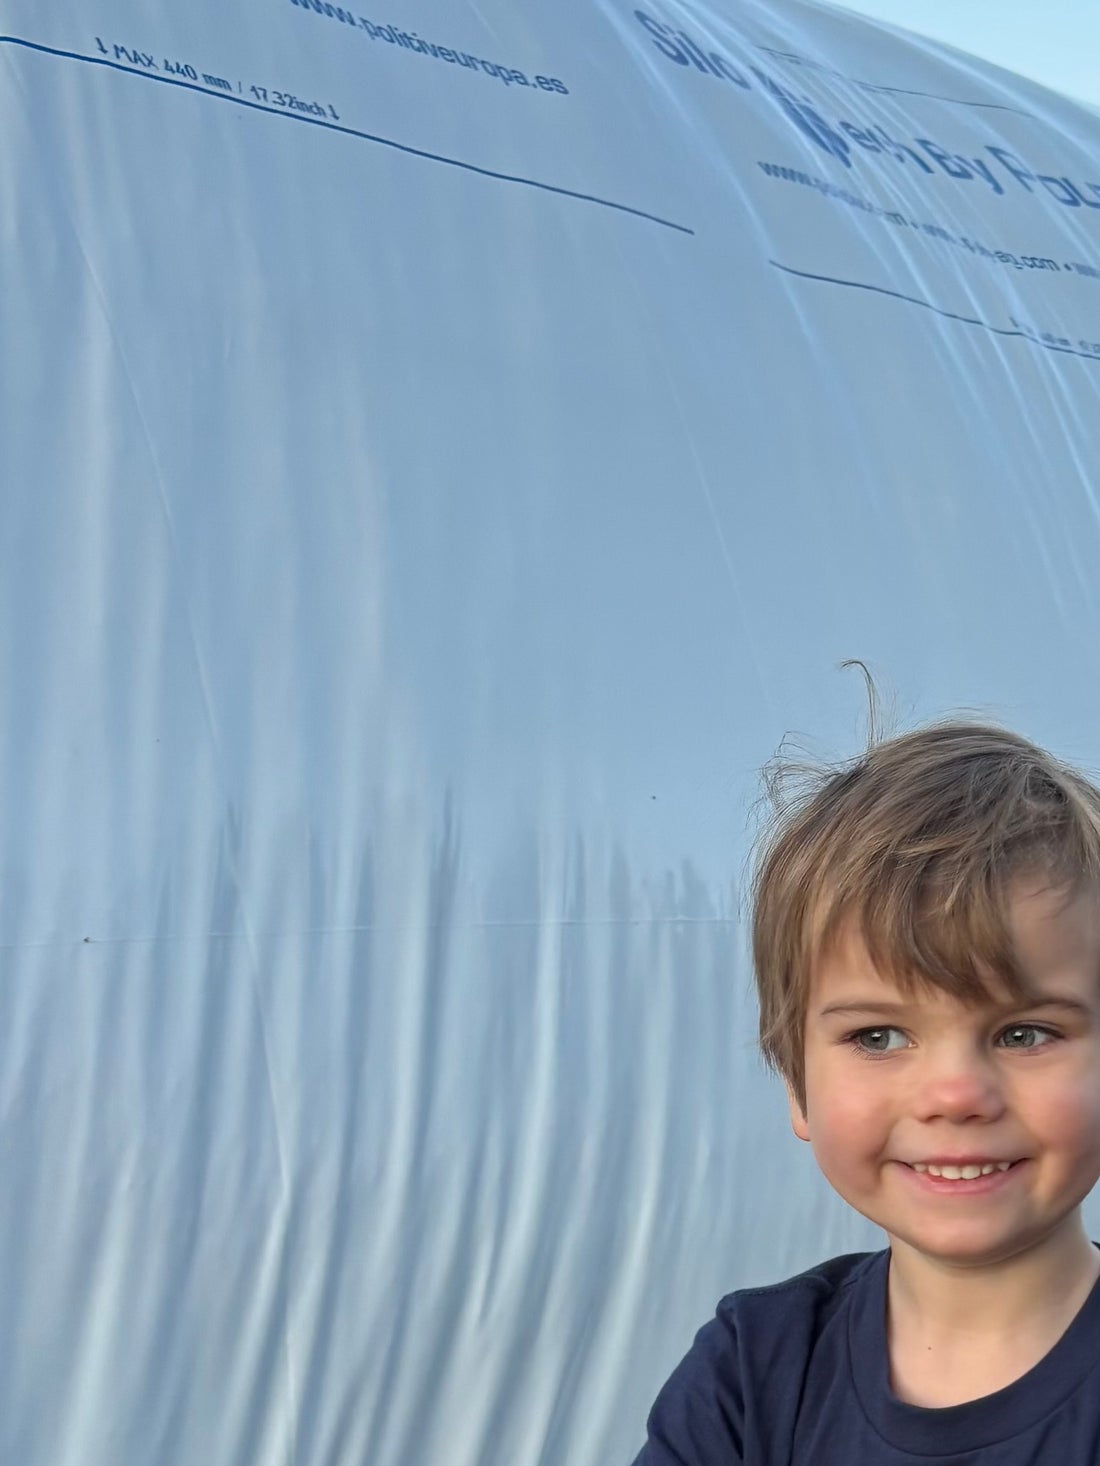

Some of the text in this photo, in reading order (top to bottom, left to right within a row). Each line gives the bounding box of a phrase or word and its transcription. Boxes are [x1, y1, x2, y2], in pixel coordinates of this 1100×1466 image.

[113, 44, 159, 70] MAX
[164, 59, 197, 80] 440
[202, 73, 232, 91] mm
